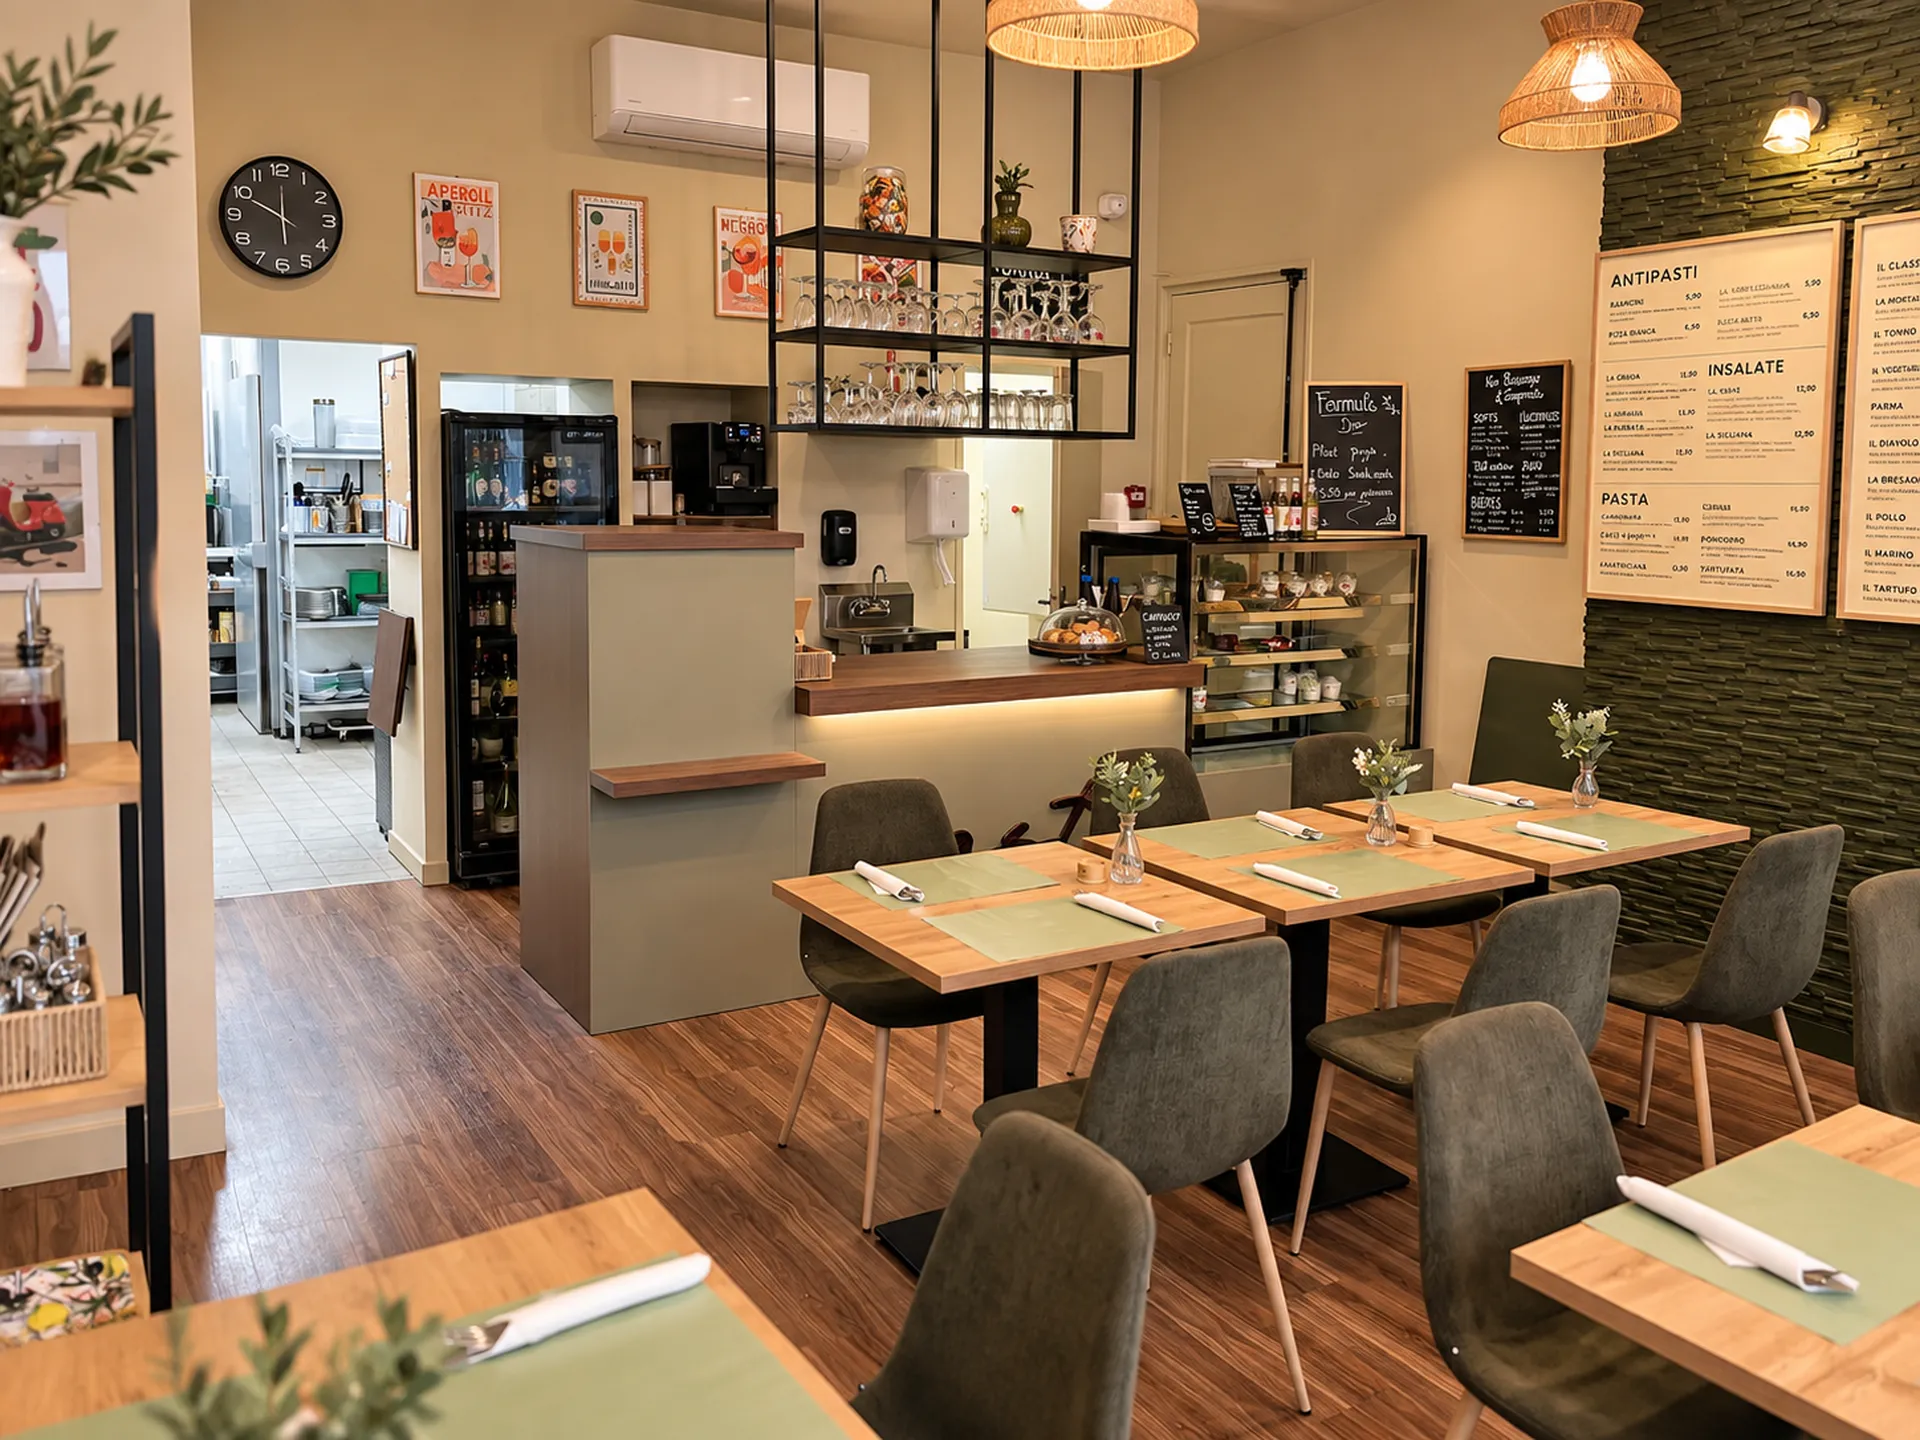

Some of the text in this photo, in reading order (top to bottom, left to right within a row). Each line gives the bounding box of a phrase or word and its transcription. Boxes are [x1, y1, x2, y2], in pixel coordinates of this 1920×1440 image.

[252, 168, 262, 182] 11
[270, 163, 290, 178] 12
[233, 185, 253, 199] 10
[314, 191, 328, 205] 2
[227, 207, 242, 221] 9
[322, 214, 336, 228] 3
[235, 232, 251, 245] 8
[315, 238, 329, 252] 4
[254, 250, 266, 265] 7
[300, 254, 312, 269] 5
[275, 258, 290, 274] 6
[1876, 263, 1885, 273] IL
[1610, 265, 1698, 288] ANTIPASTI
[1875, 298, 1886, 306] LA
[1708, 359, 1785, 377] INSALATE
[1473, 412, 1499, 423] SOFTS
[1869, 440, 1877, 448] IL
[1867, 476, 1878, 485] LA
[1601, 492, 1649, 506] PASTA
[1866, 513, 1906, 522] IL POLLO
[1864, 549, 1914, 560] IL MARINO
[1863, 584, 1917, 595] IL TARTUFO
